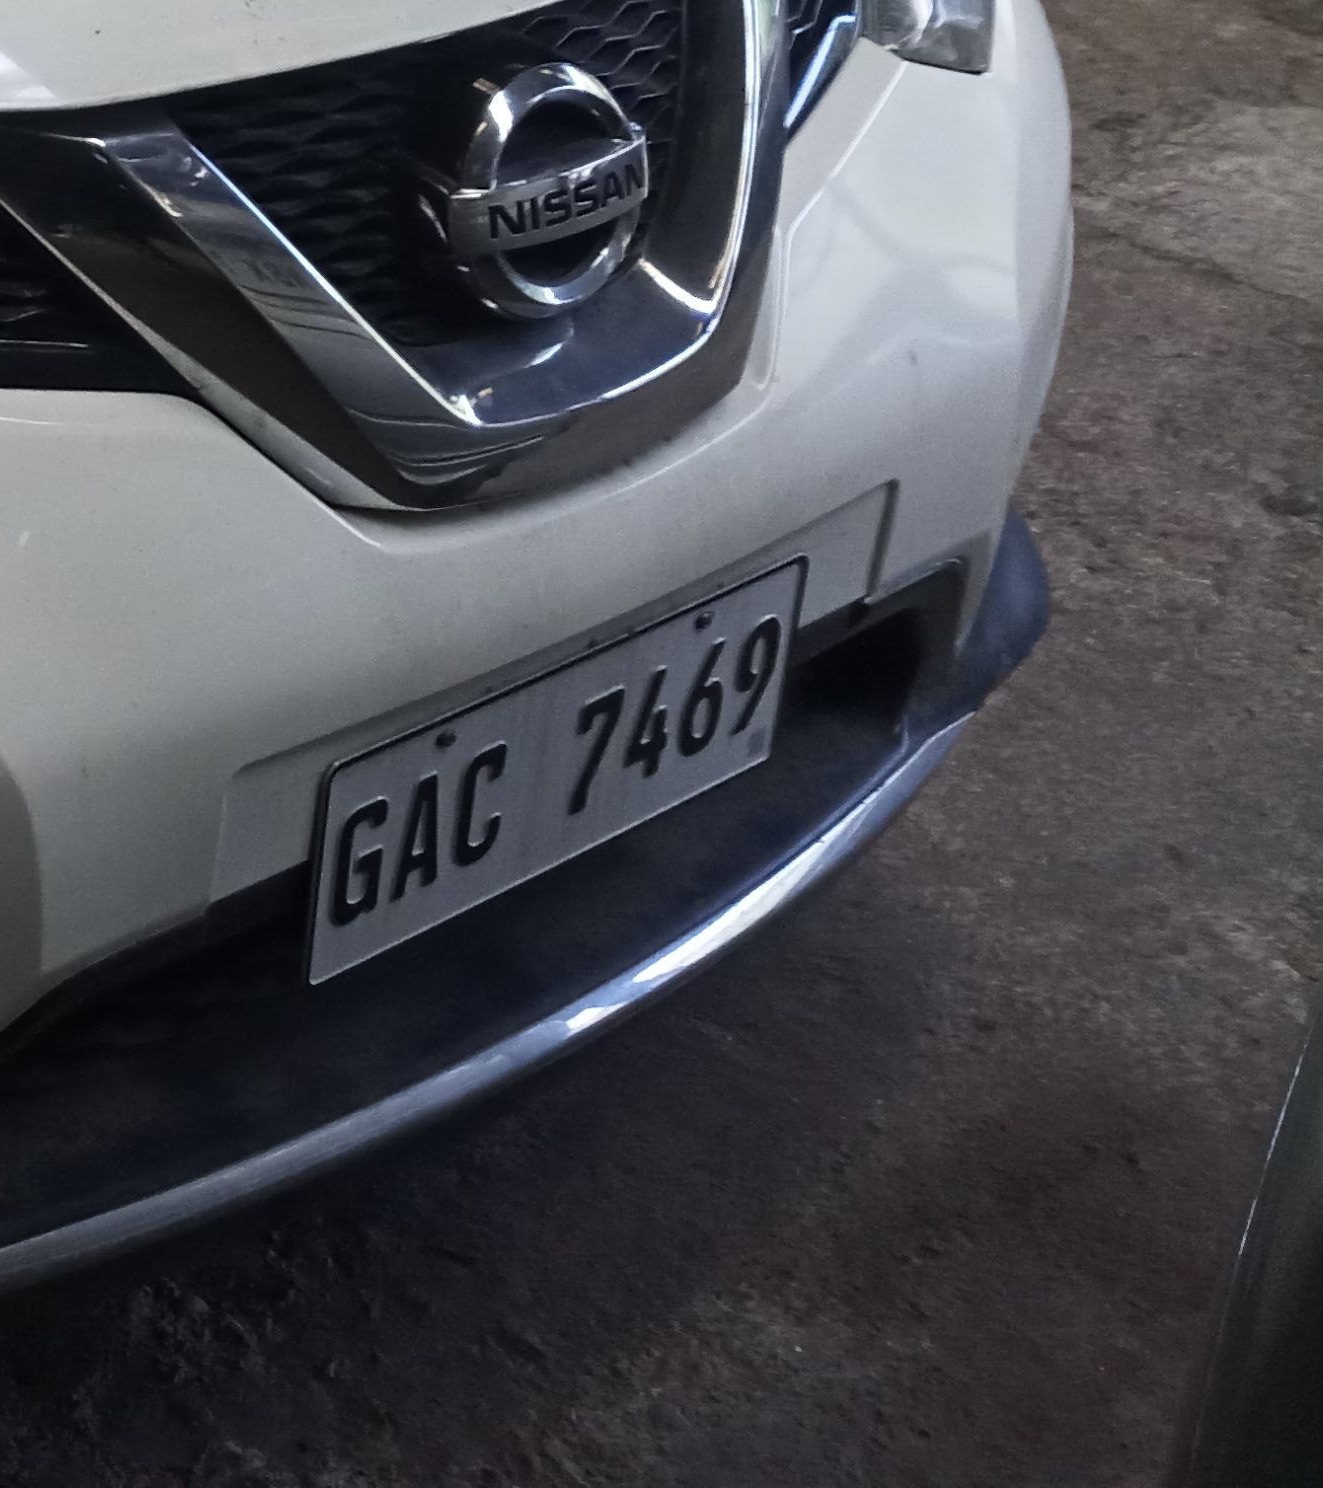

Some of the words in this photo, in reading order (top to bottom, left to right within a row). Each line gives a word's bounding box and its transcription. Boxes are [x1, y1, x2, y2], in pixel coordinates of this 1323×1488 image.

[488, 163, 645, 239] NISSAN
[331, 740, 508, 927] GAC
[566, 613, 783, 816] 7469
